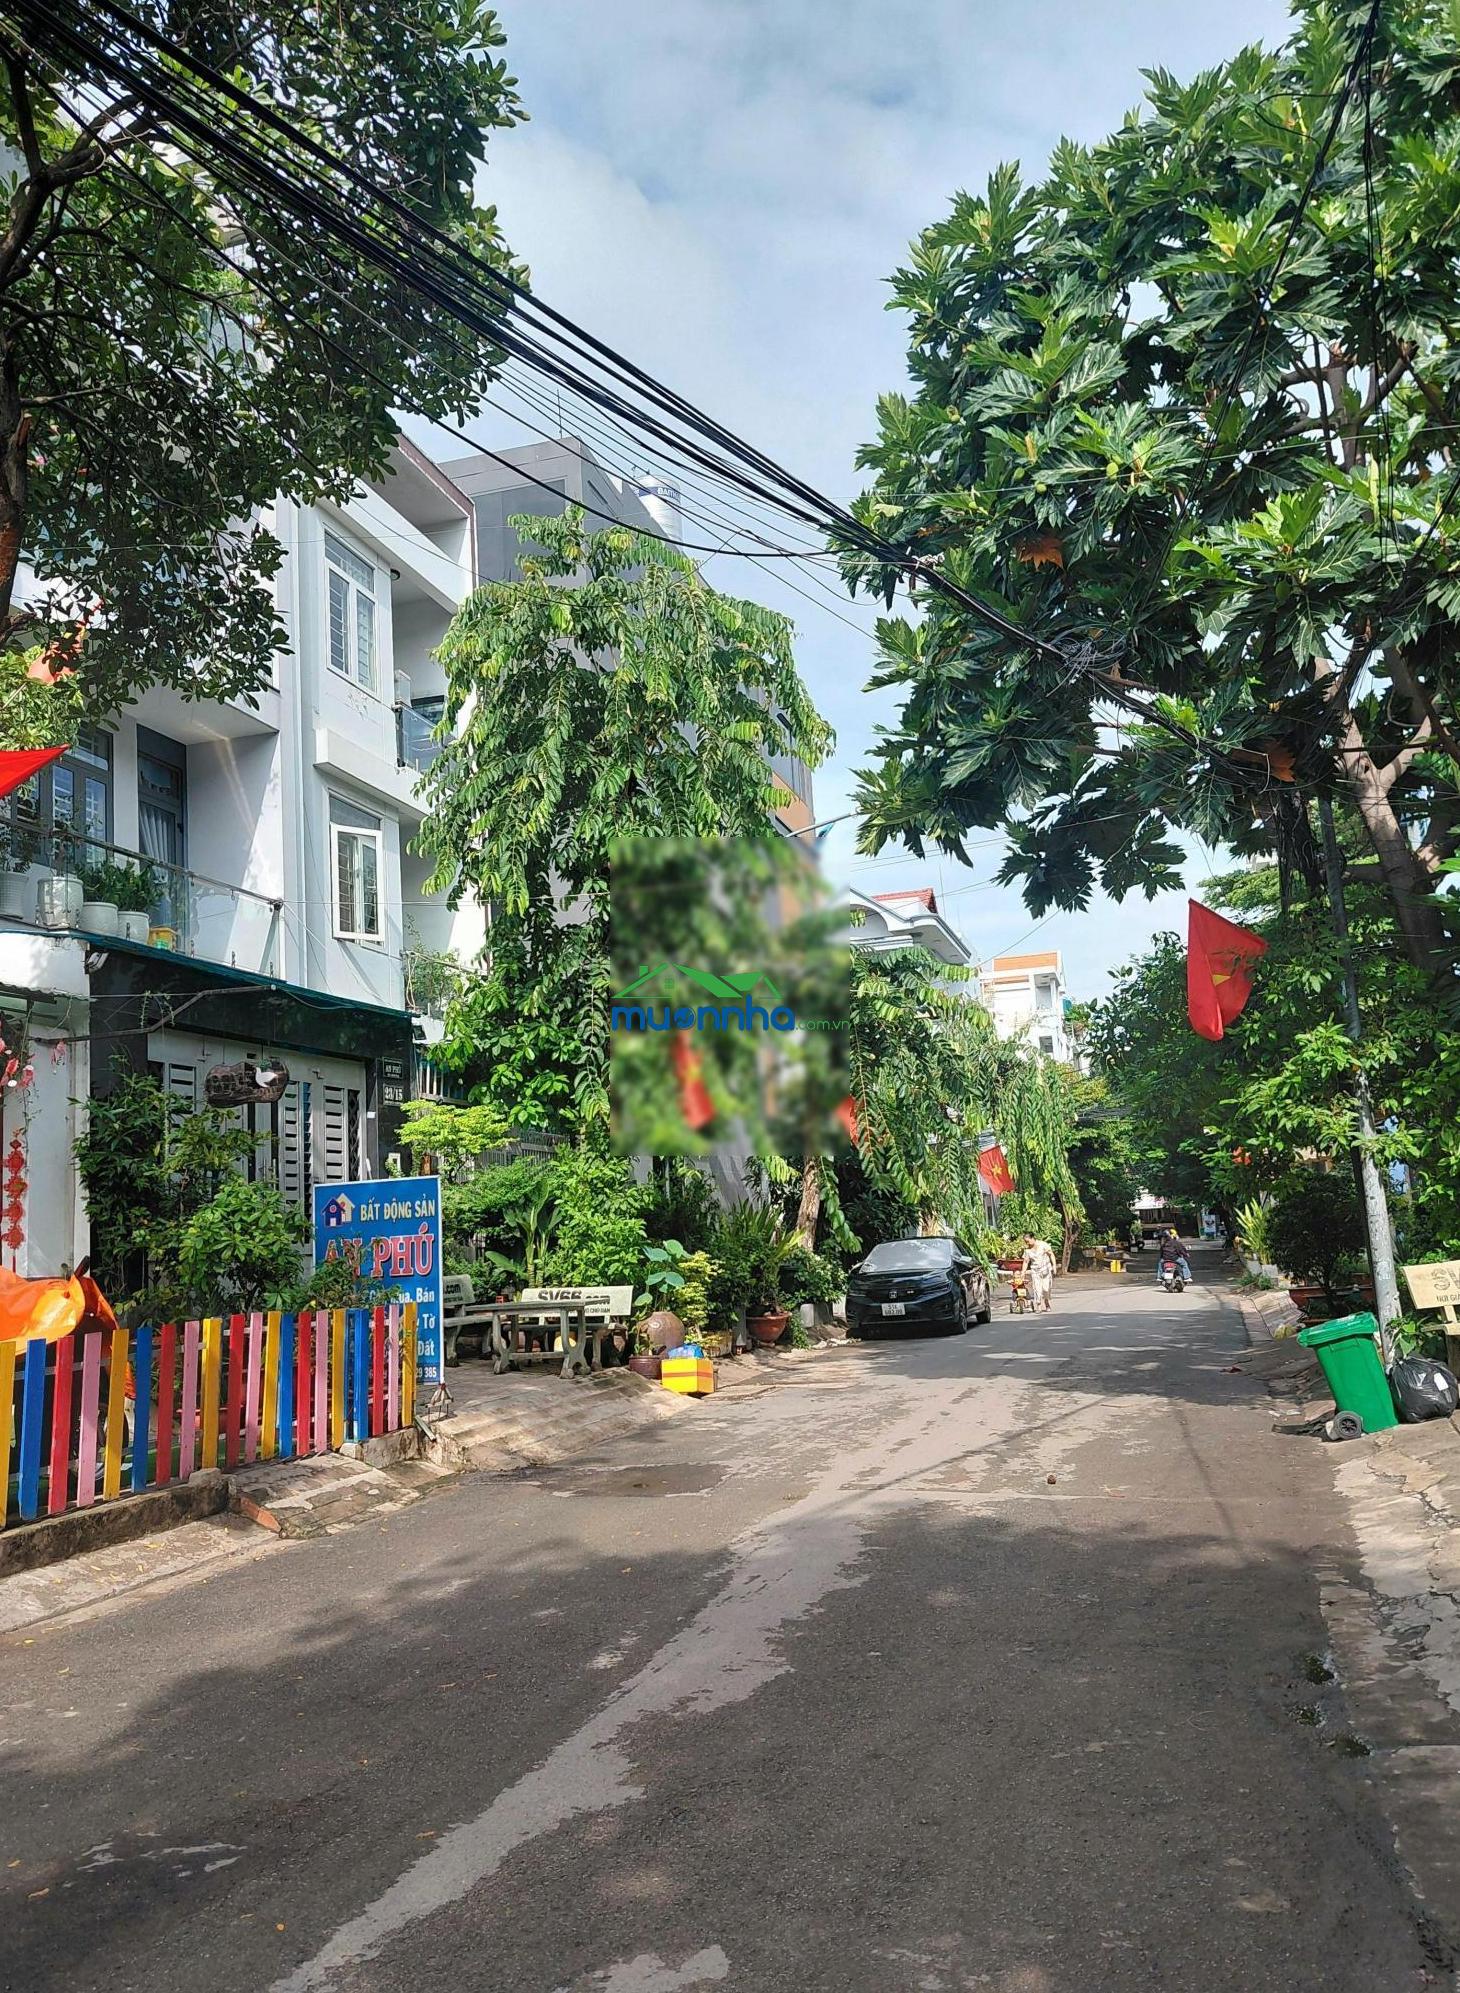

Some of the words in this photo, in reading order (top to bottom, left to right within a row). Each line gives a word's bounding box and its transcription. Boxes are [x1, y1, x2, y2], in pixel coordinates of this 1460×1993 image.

[360, 1197, 380, 1222] BẤT
[383, 1198, 412, 1223] ĐỘNG
[414, 1193, 435, 1217] SẢN
[370, 1222, 434, 1277] PHÚ
[416, 1287, 435, 1303] Bán
[422, 1313, 436, 1329] Tờ
[424, 1366, 437, 1378] 385
